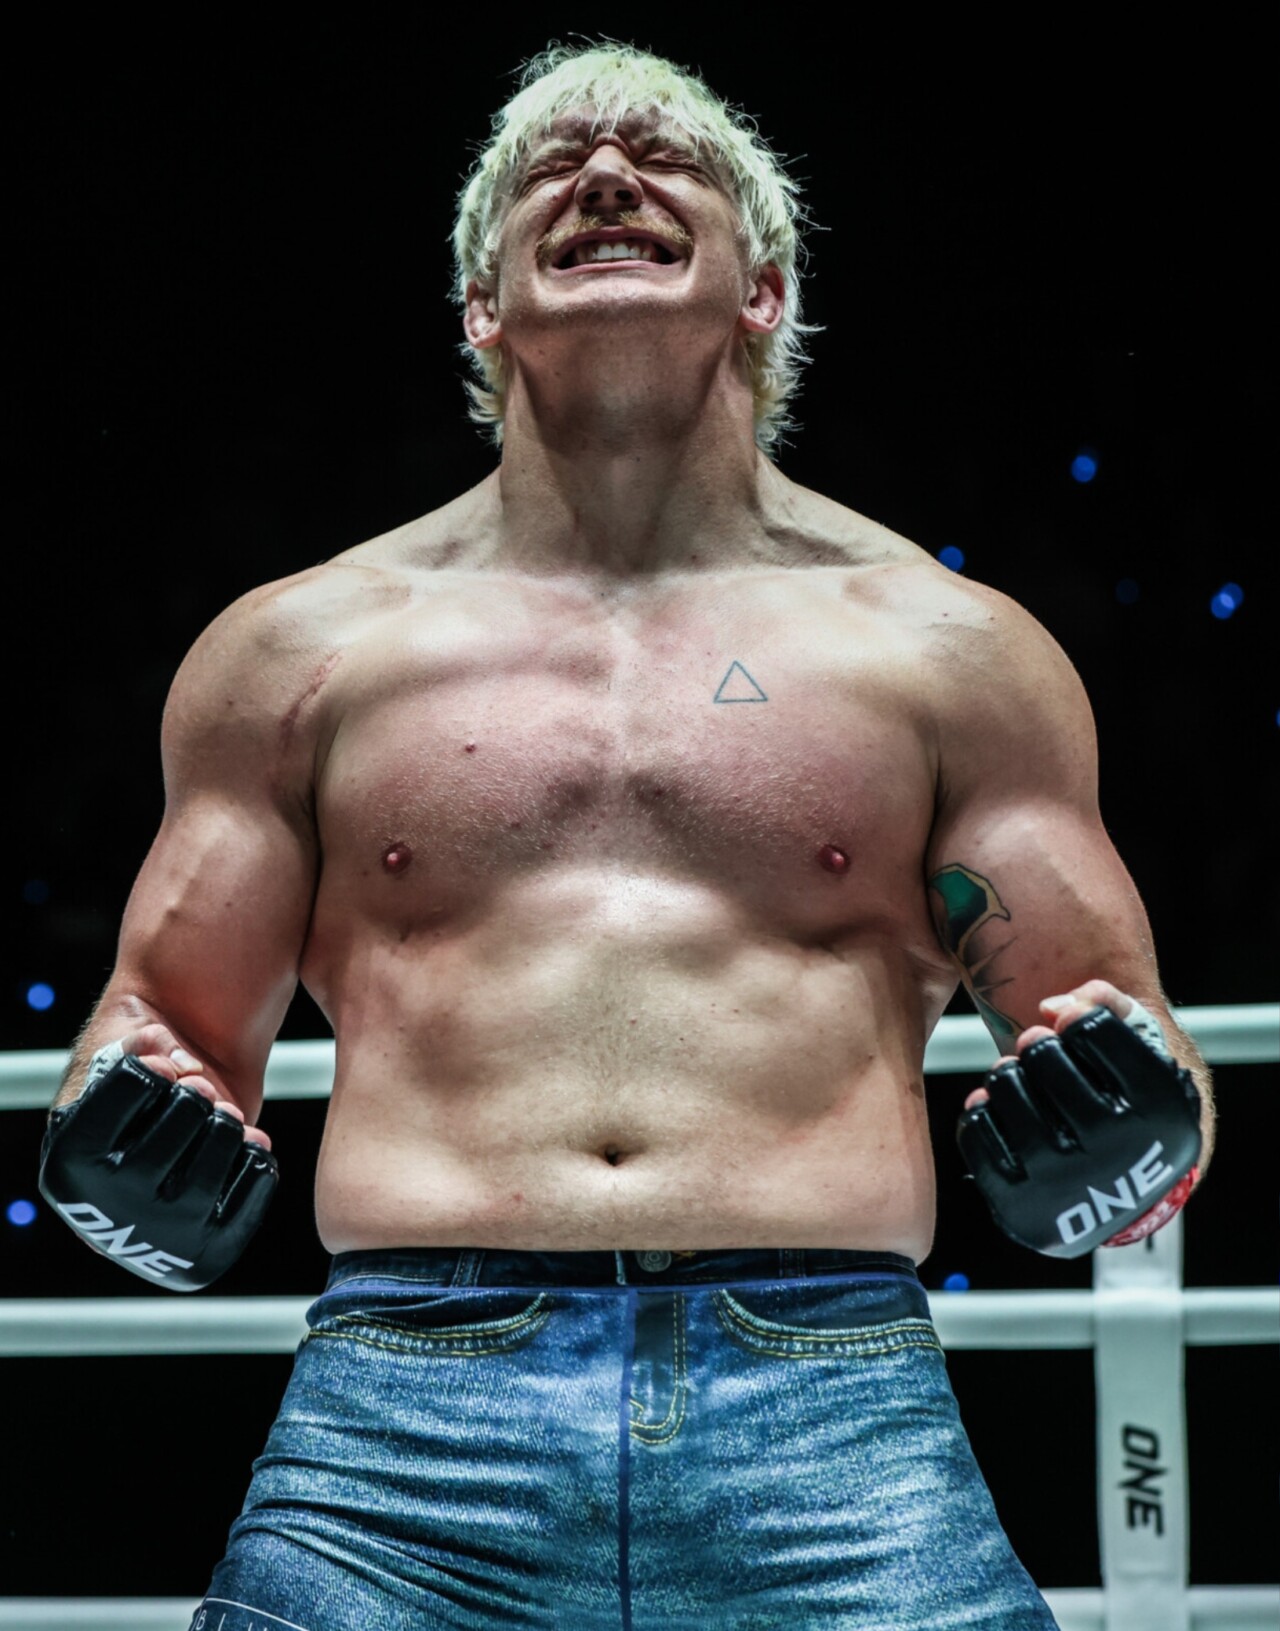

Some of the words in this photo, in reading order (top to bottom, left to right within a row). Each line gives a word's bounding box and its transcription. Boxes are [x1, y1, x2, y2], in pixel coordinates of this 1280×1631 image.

[57, 1203, 194, 1278] ONE
[1056, 1140, 1174, 1244] ONE
[1117, 1422, 1166, 1539] ONE
